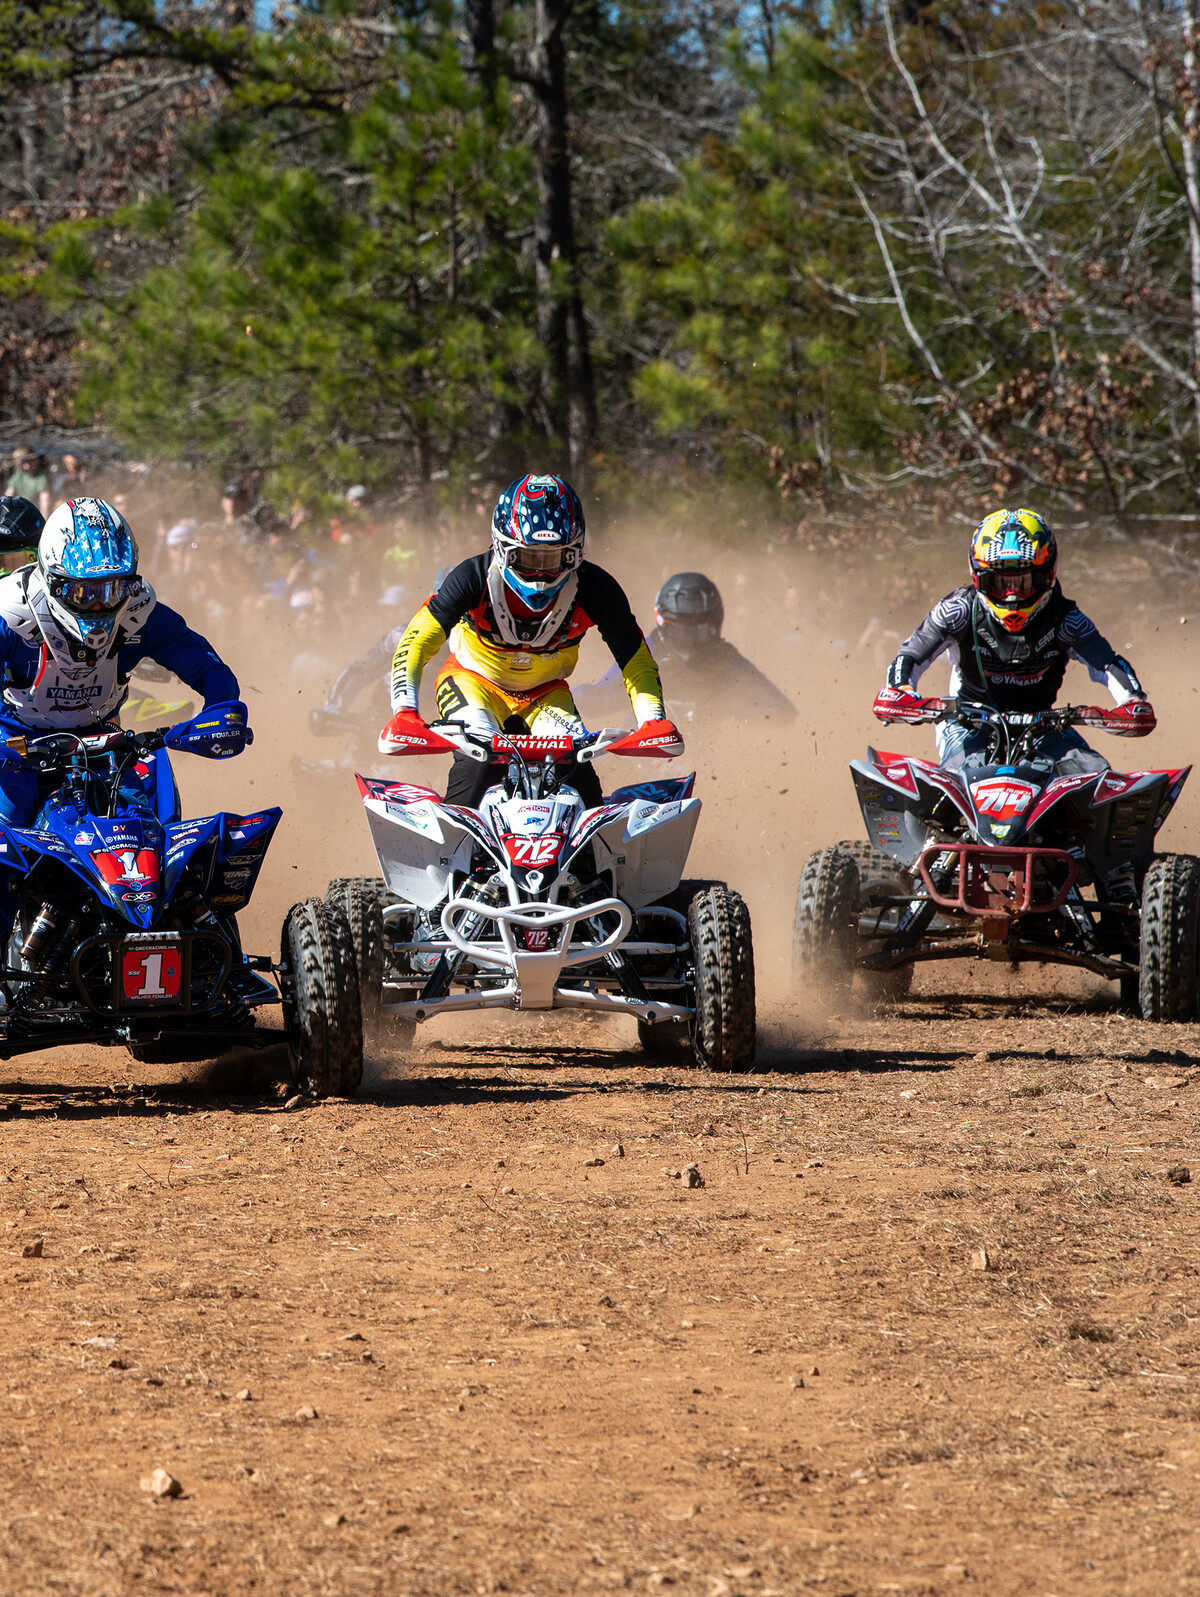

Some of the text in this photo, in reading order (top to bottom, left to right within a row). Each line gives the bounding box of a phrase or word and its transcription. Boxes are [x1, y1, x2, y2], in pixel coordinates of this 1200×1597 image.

[977, 628, 998, 648] LEATT
[392, 650, 409, 699] RACING
[1004, 675, 1043, 686] YAMAHA
[50, 687, 99, 699] YAMAHA
[211, 730, 241, 740] FOWLER
[387, 733, 428, 746] ACERBIS
[638, 735, 678, 748] ACERBIS
[496, 739, 568, 750] RENTHAL
[621, 783, 665, 799] 712
[976, 792, 1031, 812] 714
[113, 834, 138, 842] YAMAHA
[514, 838, 559, 861] 712
[117, 851, 145, 879] 1
[528, 931, 547, 945] 712
[138, 952, 166, 995] 1
